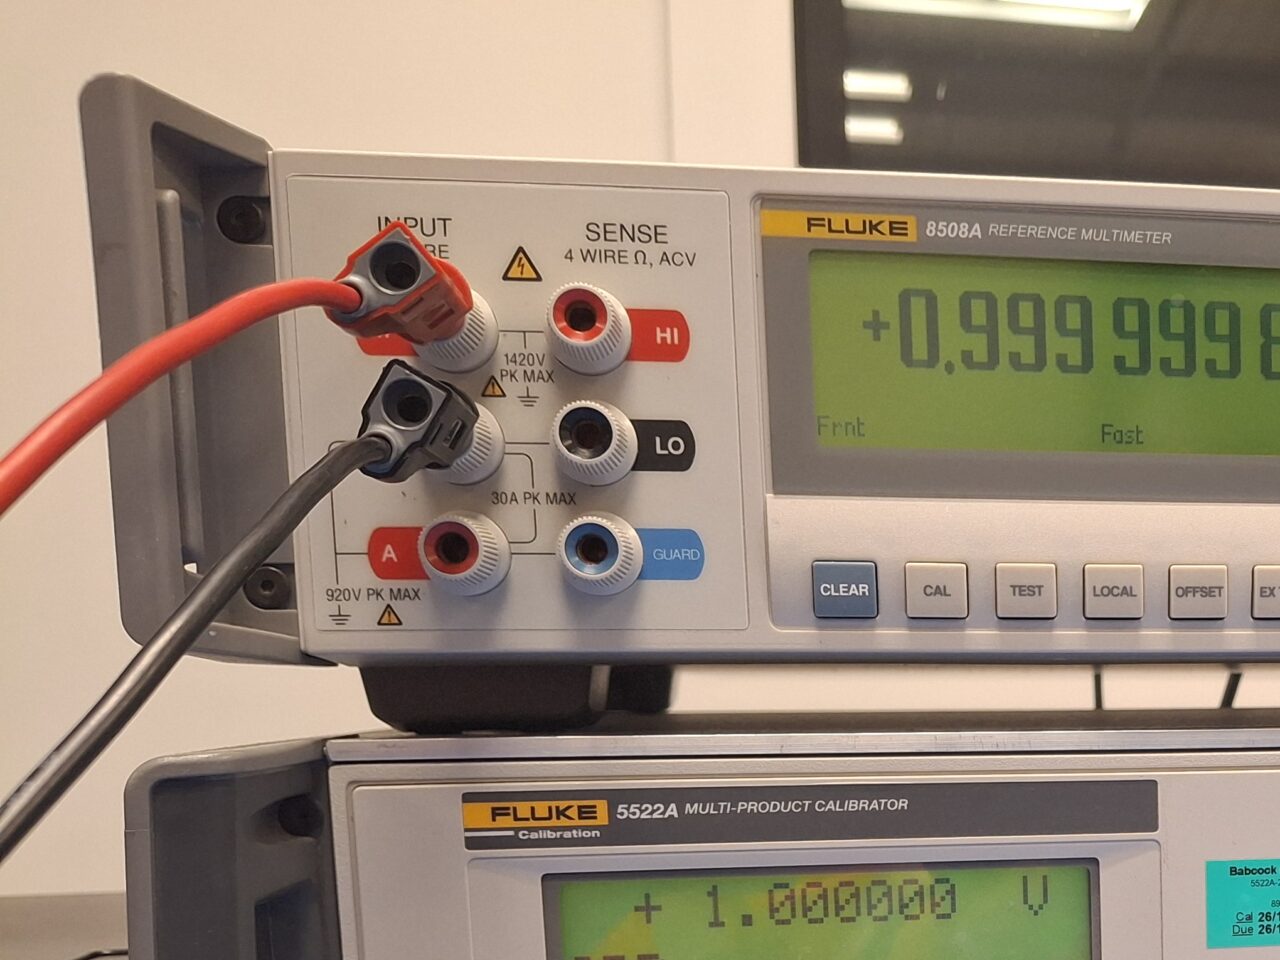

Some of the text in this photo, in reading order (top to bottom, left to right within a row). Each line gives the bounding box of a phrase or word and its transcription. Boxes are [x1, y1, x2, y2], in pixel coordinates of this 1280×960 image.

[586, 222, 668, 244] SENSE
[807, 217, 909, 237] FLUKE
[925, 221, 1172, 245] 8508A REFERENCE MULTIMETER
[578, 249, 696, 267] WIRE ACV
[656, 327, 679, 345] HI
[504, 354, 546, 367] 1420V
[500, 369, 554, 384] PK MAX
[1101, 423, 1145, 445] Fast
[655, 436, 685, 456] LO
[491, 491, 577, 506] 30A PK MAX
[381, 544, 398, 562] A
[652, 548, 700, 561] GUARD
[326, 588, 421, 602] 920V PK MAX
[820, 583, 869, 597] CLEAR
[923, 584, 951, 598] CAL
[1010, 584, 1044, 598] TEST
[1093, 585, 1137, 598] LOCAL
[1175, 585, 1224, 599] OFFSET
[1259, 586, 1276, 598] EX
[491, 804, 598, 823] FLUKE
[616, 798, 909, 820] 5522A MULTI-PRODUCT CALIBRATOR
[518, 828, 601, 840] Calibration
[1229, 864, 1277, 877] Babcock
[707, 877, 957, 928] 1.000000
[1235, 912, 1253, 924] Cal
[1232, 924, 1254, 936] Due
